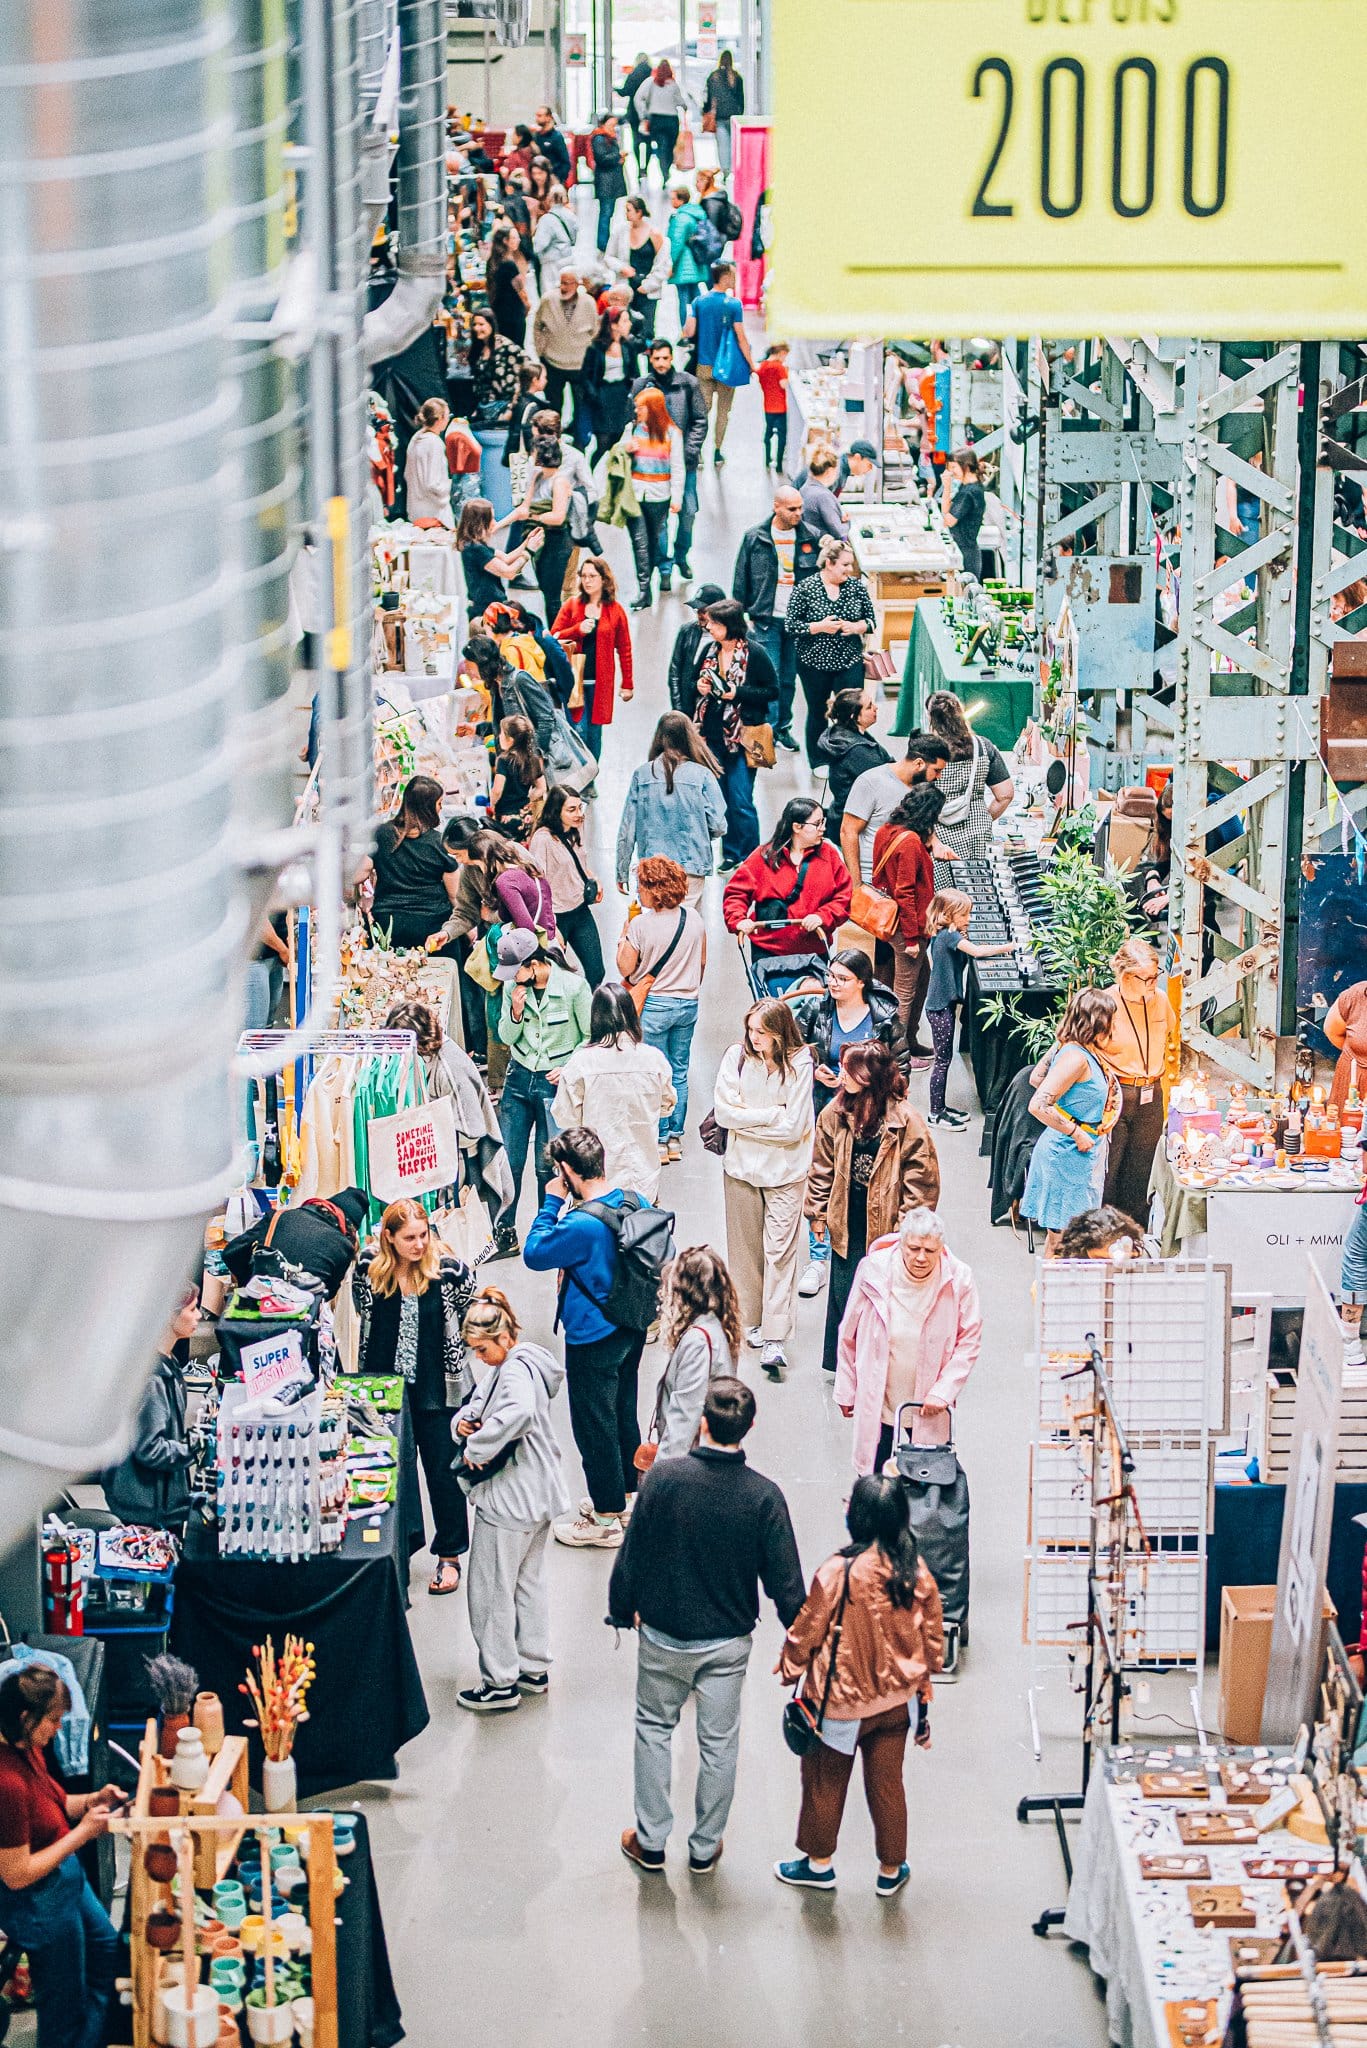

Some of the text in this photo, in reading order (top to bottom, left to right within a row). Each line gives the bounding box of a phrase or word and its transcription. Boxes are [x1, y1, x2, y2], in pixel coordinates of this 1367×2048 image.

[972, 57, 1229, 218] 2000
[398, 1143, 415, 1162] SAD
[398, 1153, 437, 1177] HAPPY!
[1266, 1234, 1289, 1245] OLI
[1310, 1234, 1343, 1245] MIMI
[253, 1347, 289, 1370] SUPER
